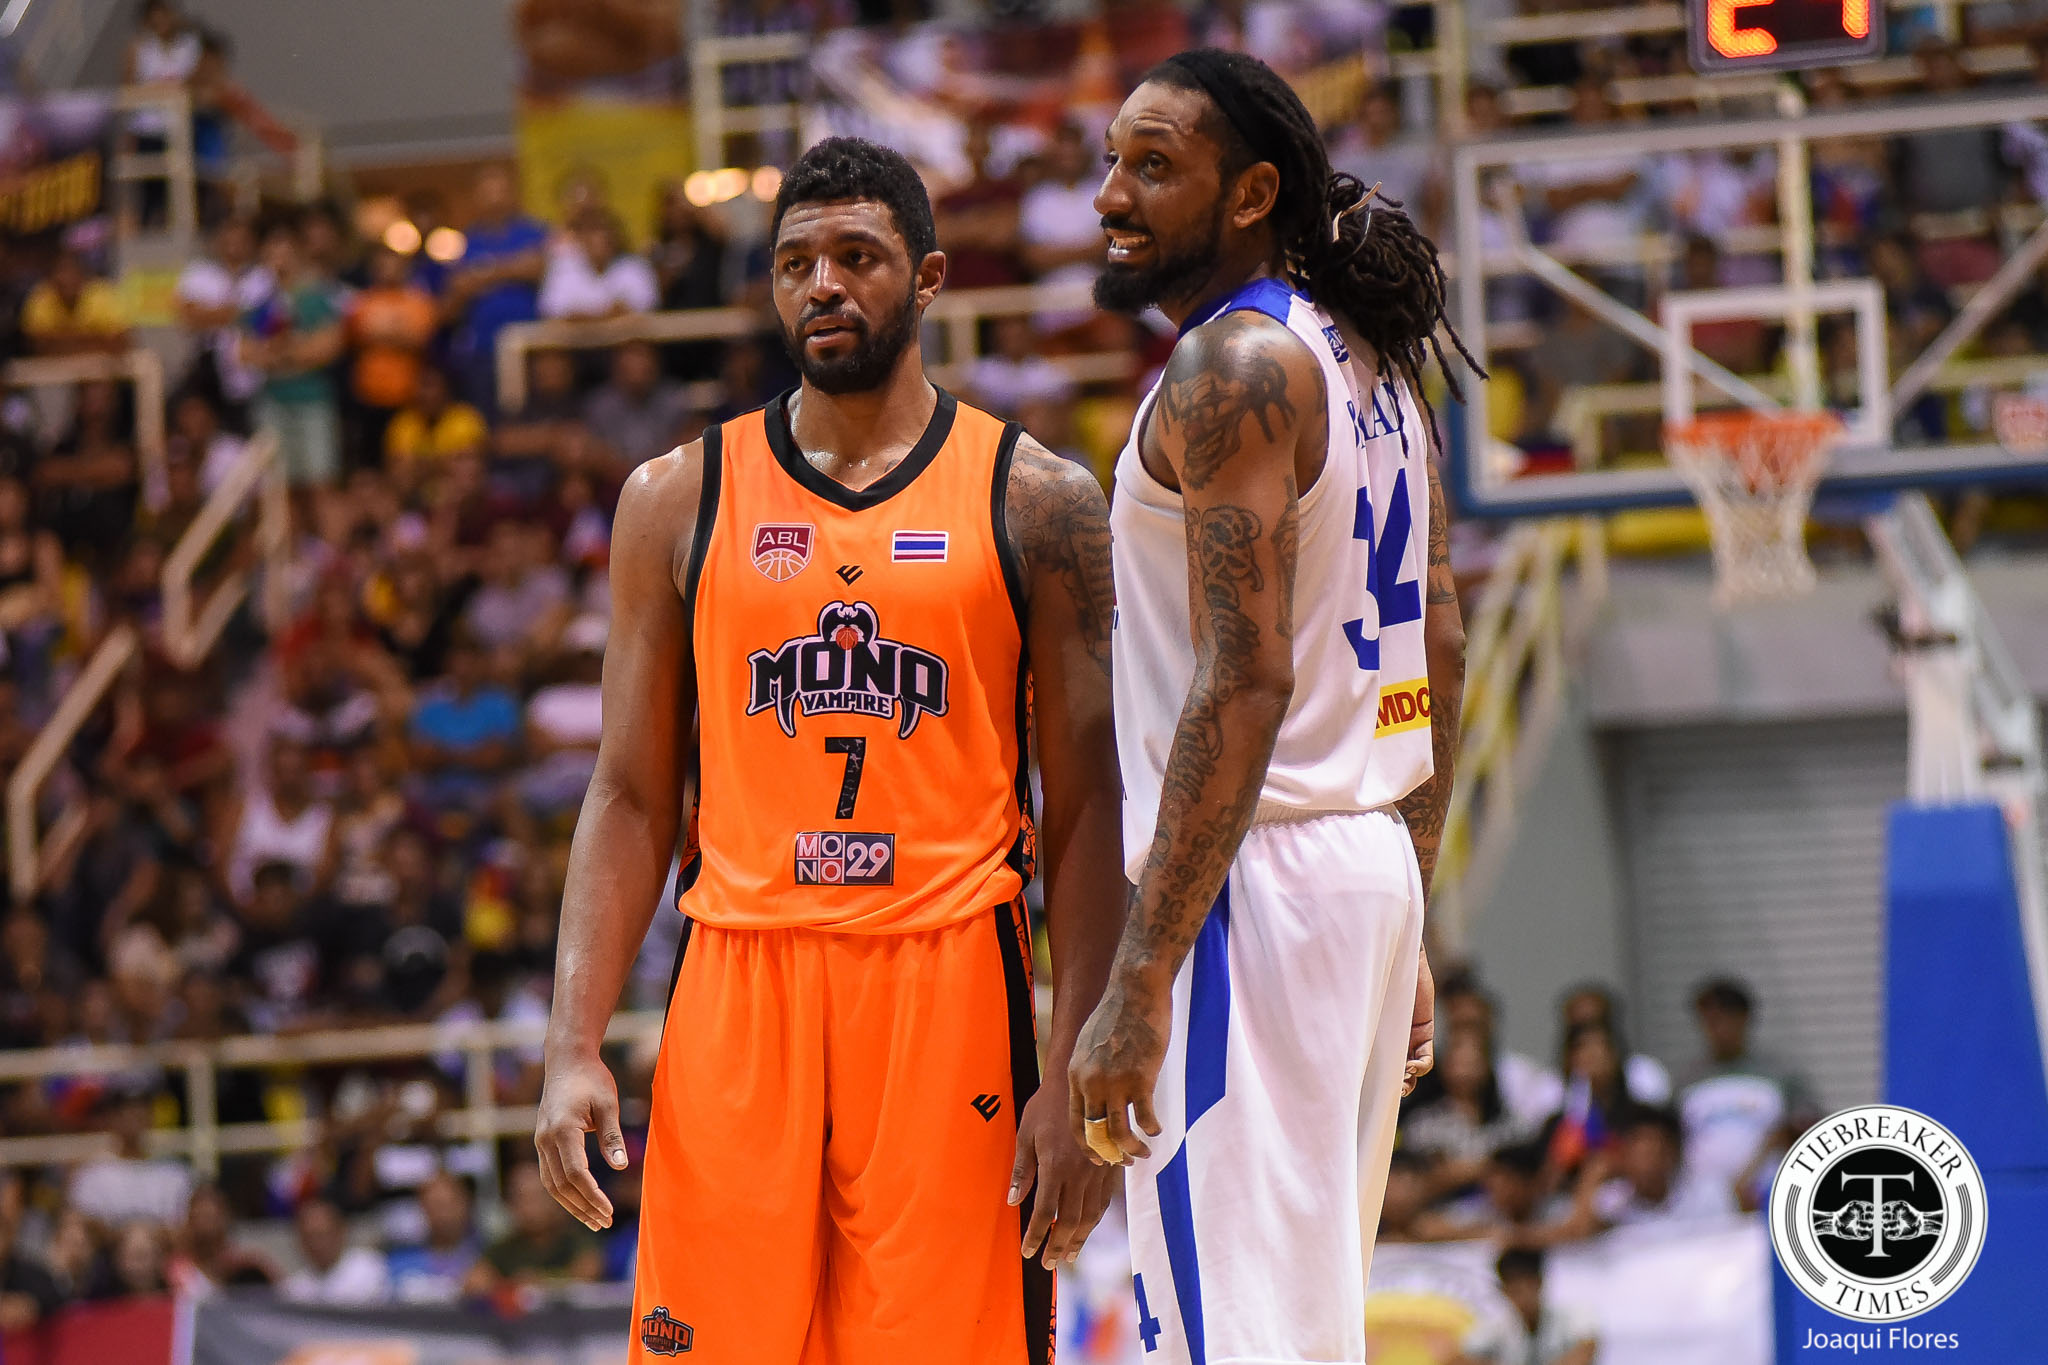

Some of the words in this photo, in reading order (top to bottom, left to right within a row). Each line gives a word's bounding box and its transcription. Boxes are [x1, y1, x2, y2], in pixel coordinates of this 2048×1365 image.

[758, 531, 806, 549] ABL
[746, 637, 949, 736] MONO
[803, 691, 890, 715] VAMPIRE
[824, 736, 867, 820] 7
